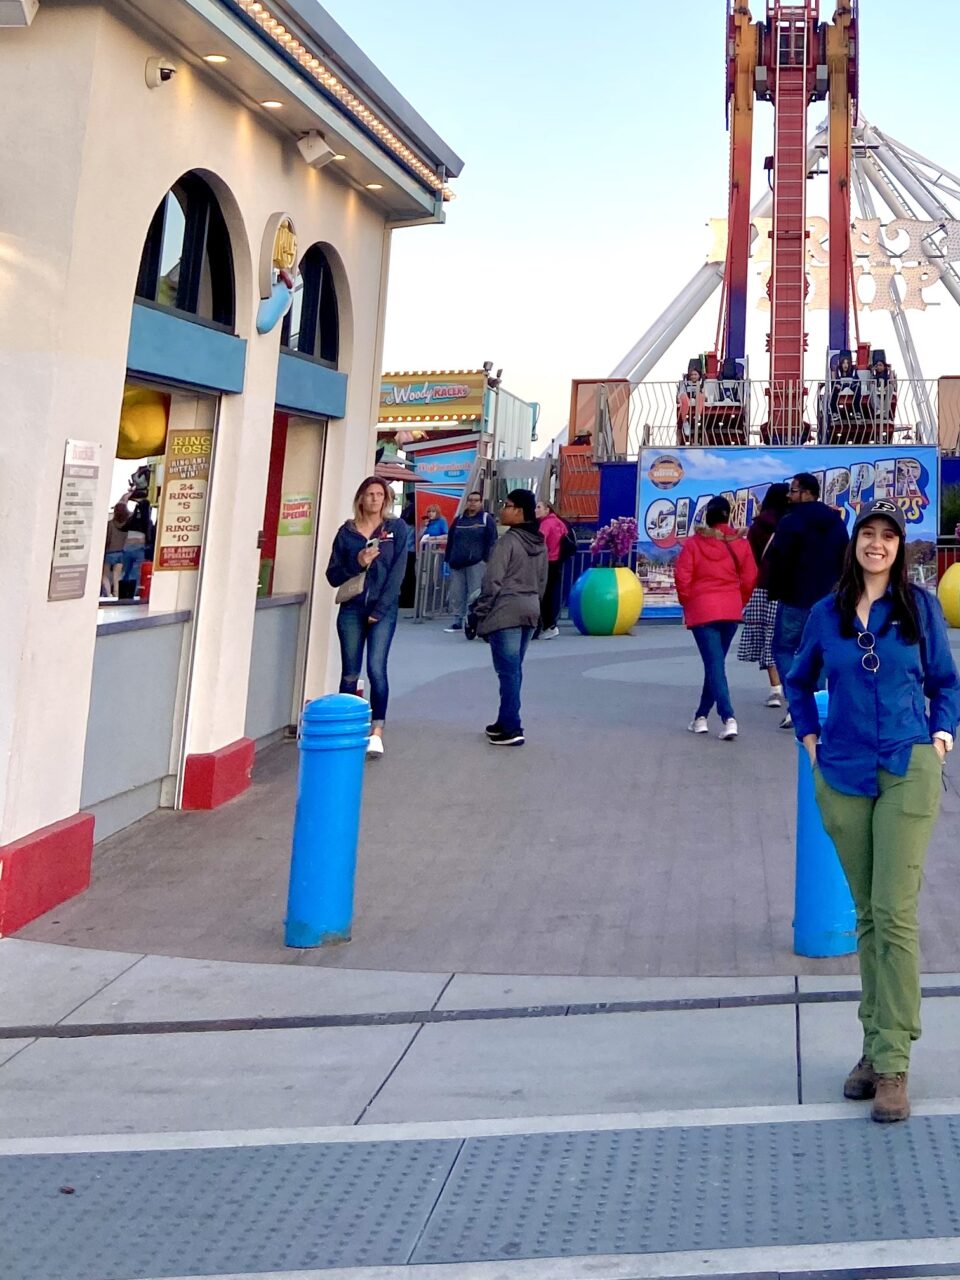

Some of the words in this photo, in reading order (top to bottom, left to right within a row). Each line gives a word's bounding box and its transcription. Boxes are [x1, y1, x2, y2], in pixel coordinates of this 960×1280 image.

[386, 382, 432, 404] Woody
[173, 436, 210, 445] RING
[172, 445, 210, 454] TOSS
[180, 483, 194, 491] 24
[871, 501, 896, 512] P
